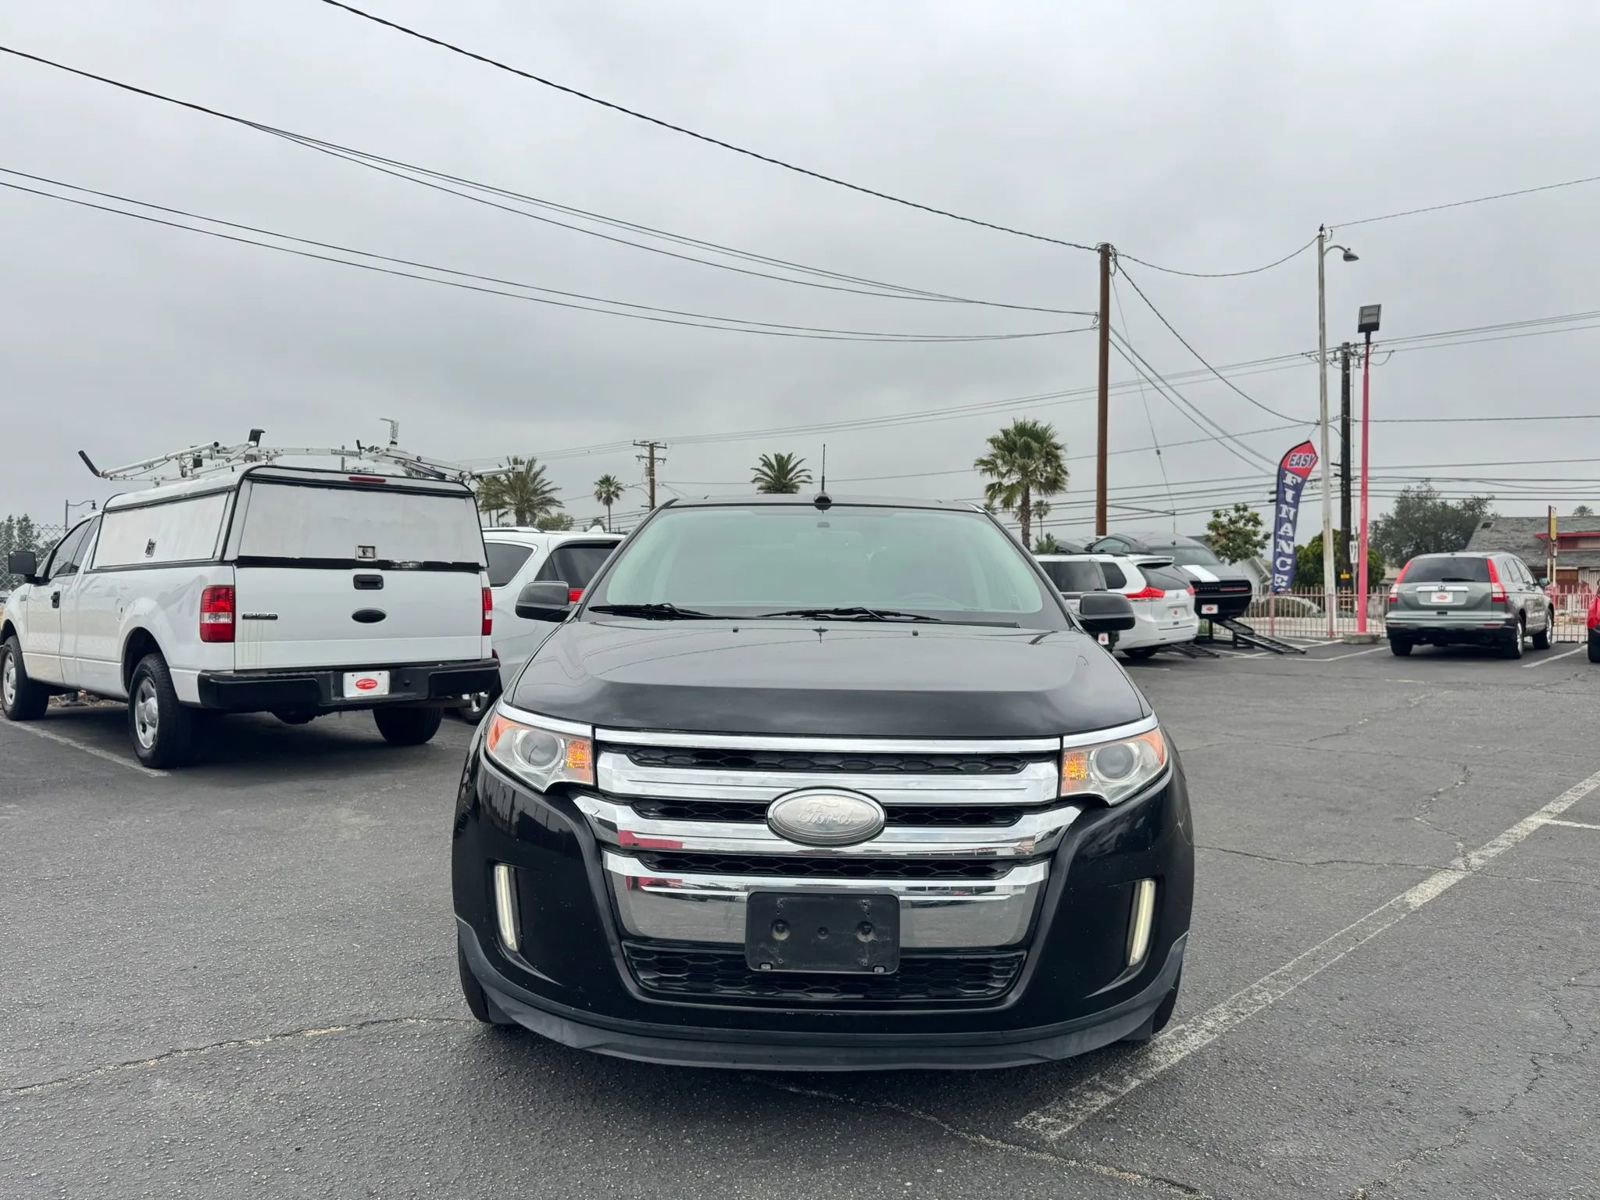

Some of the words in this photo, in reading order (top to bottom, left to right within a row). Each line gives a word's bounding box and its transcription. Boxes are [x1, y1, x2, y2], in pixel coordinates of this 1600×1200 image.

[1288, 453, 1317, 469] EASY
[1273, 471, 1302, 587] FINANCE
[798, 801, 856, 826] Ford
